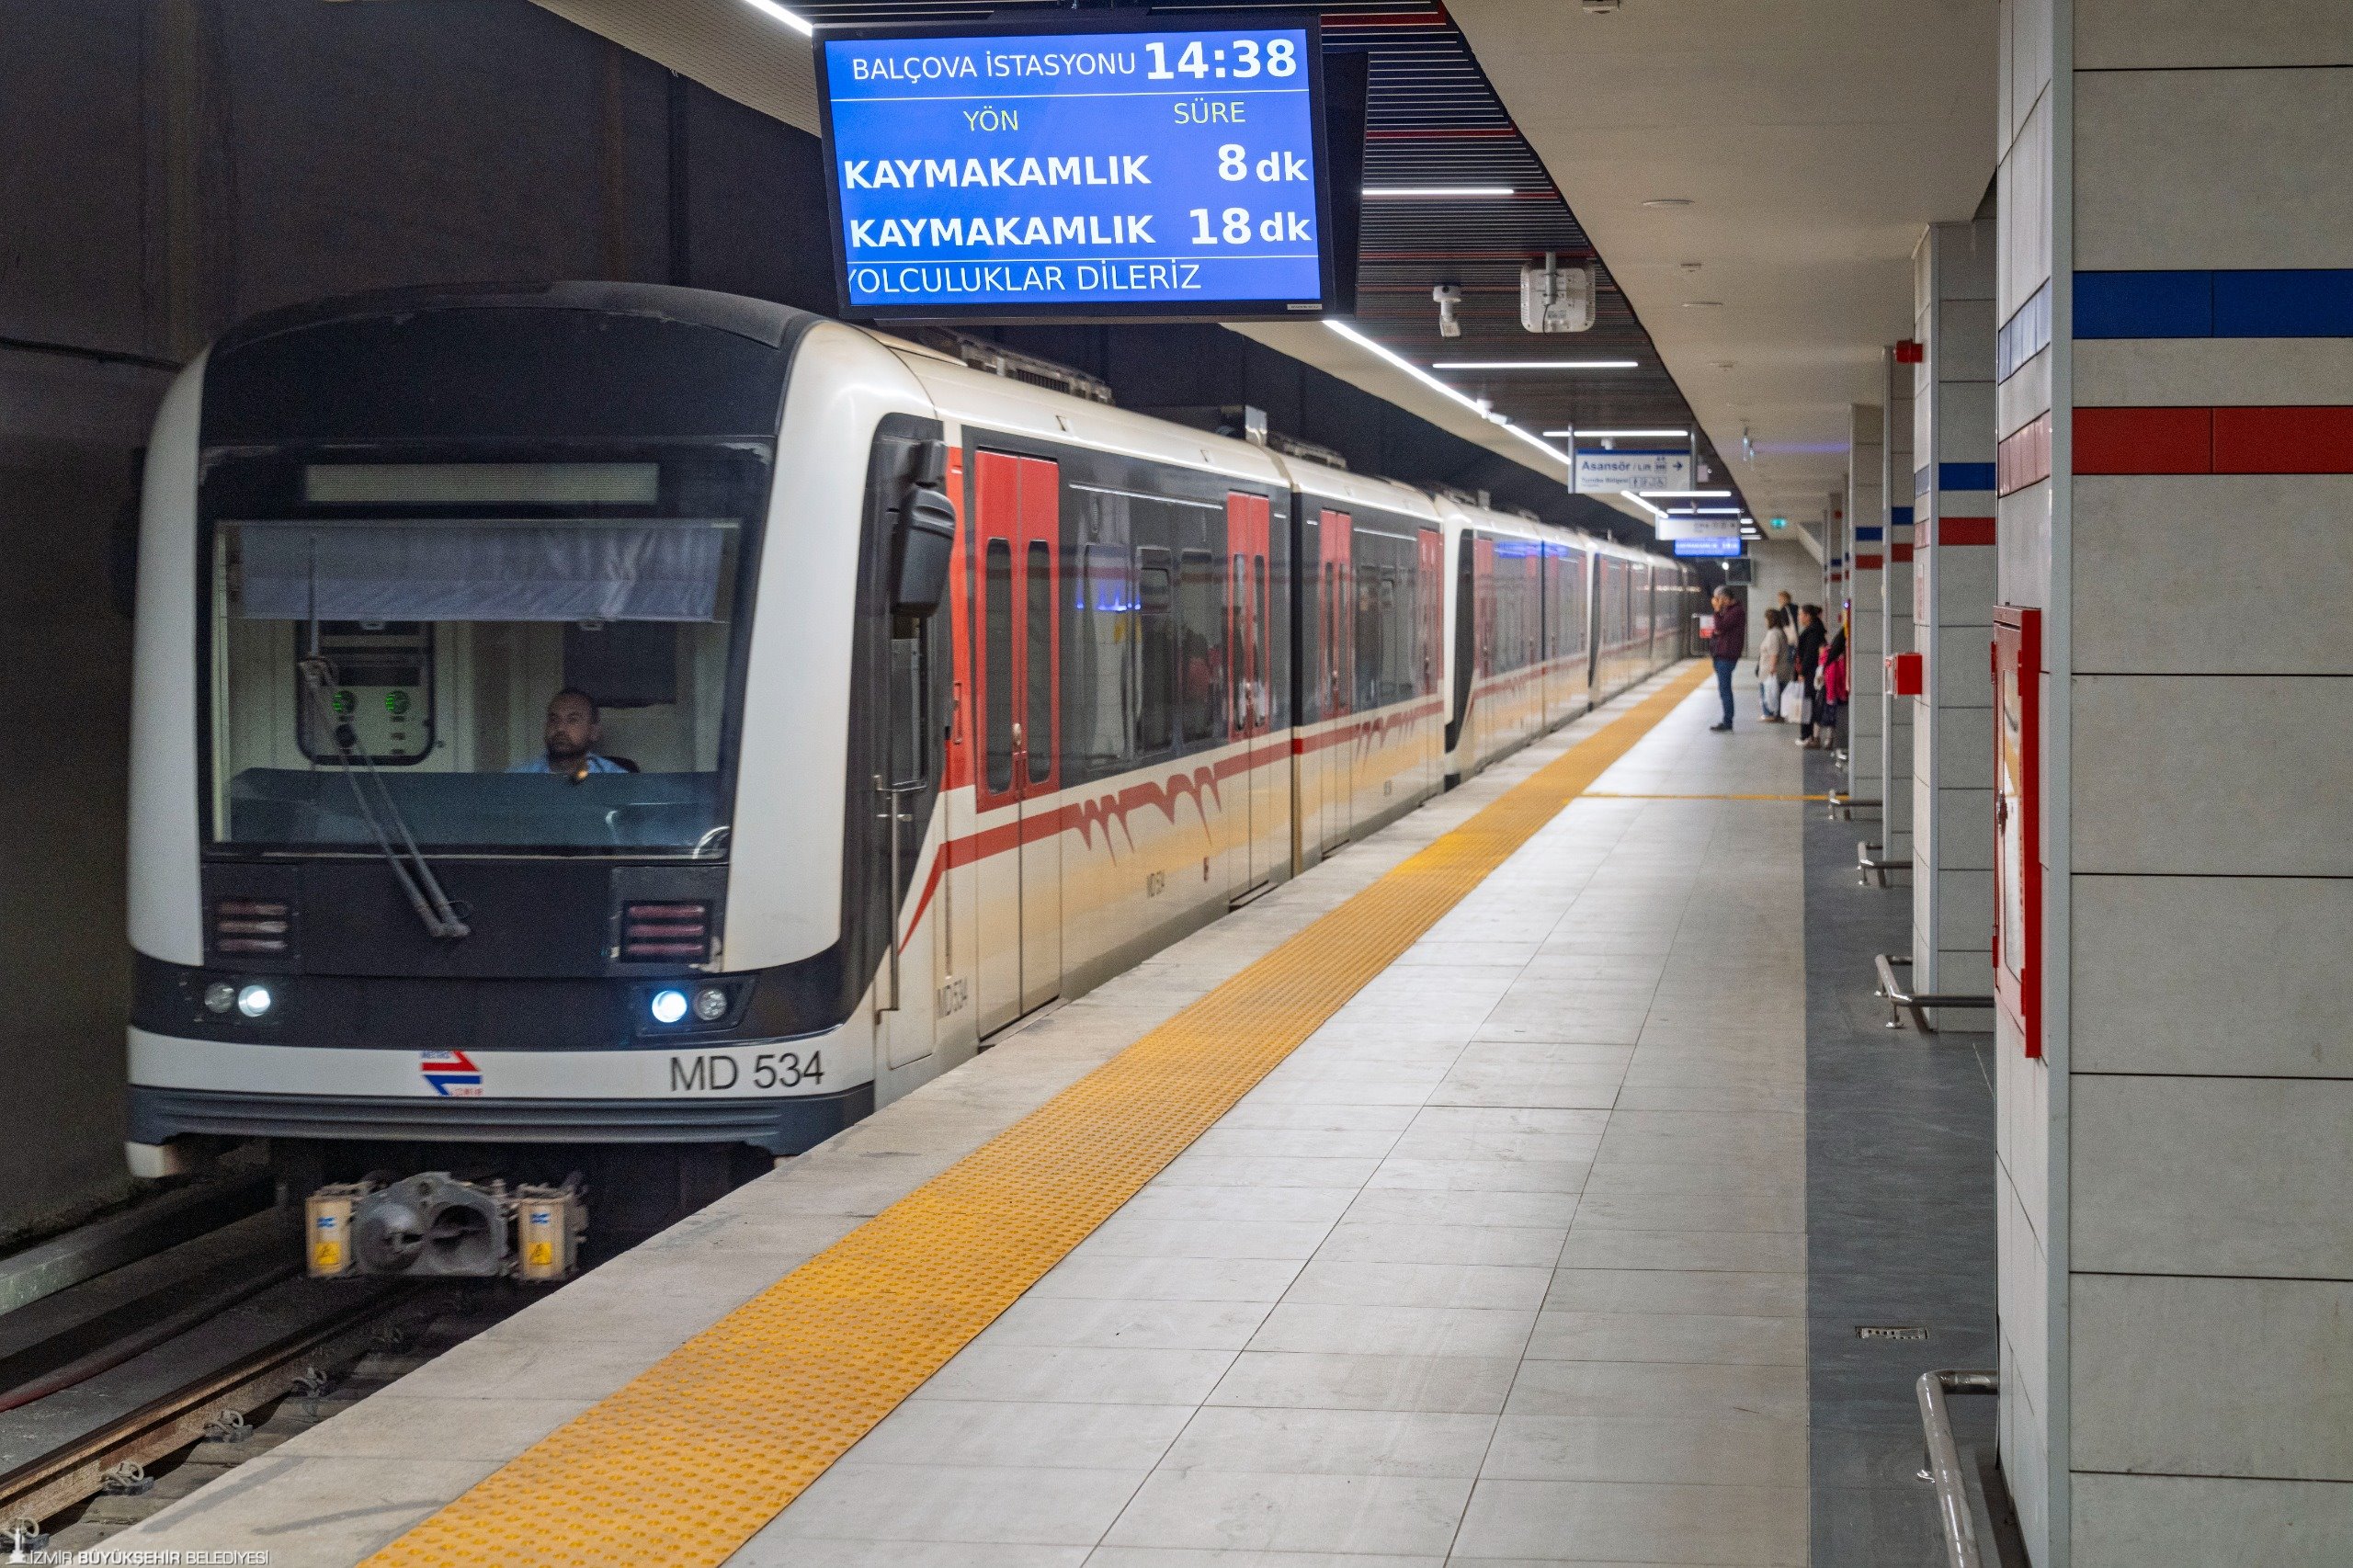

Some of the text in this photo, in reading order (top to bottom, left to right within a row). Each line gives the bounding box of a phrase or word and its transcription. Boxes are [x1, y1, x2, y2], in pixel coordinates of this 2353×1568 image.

[851, 39, 1297, 84] BALÇOVA İSTASYONU 14:38
[963, 98, 1246, 131] YÖN SÜRE
[844, 143, 1309, 189] KAYMAKAMLIK 8 dk
[850, 208, 1312, 248] KAYMAKAMLIK 18 dk
[1077, 258, 1201, 291] DİLERİZ
[1581, 460, 1631, 472] Asansör
[671, 1051, 824, 1091] MD 534
